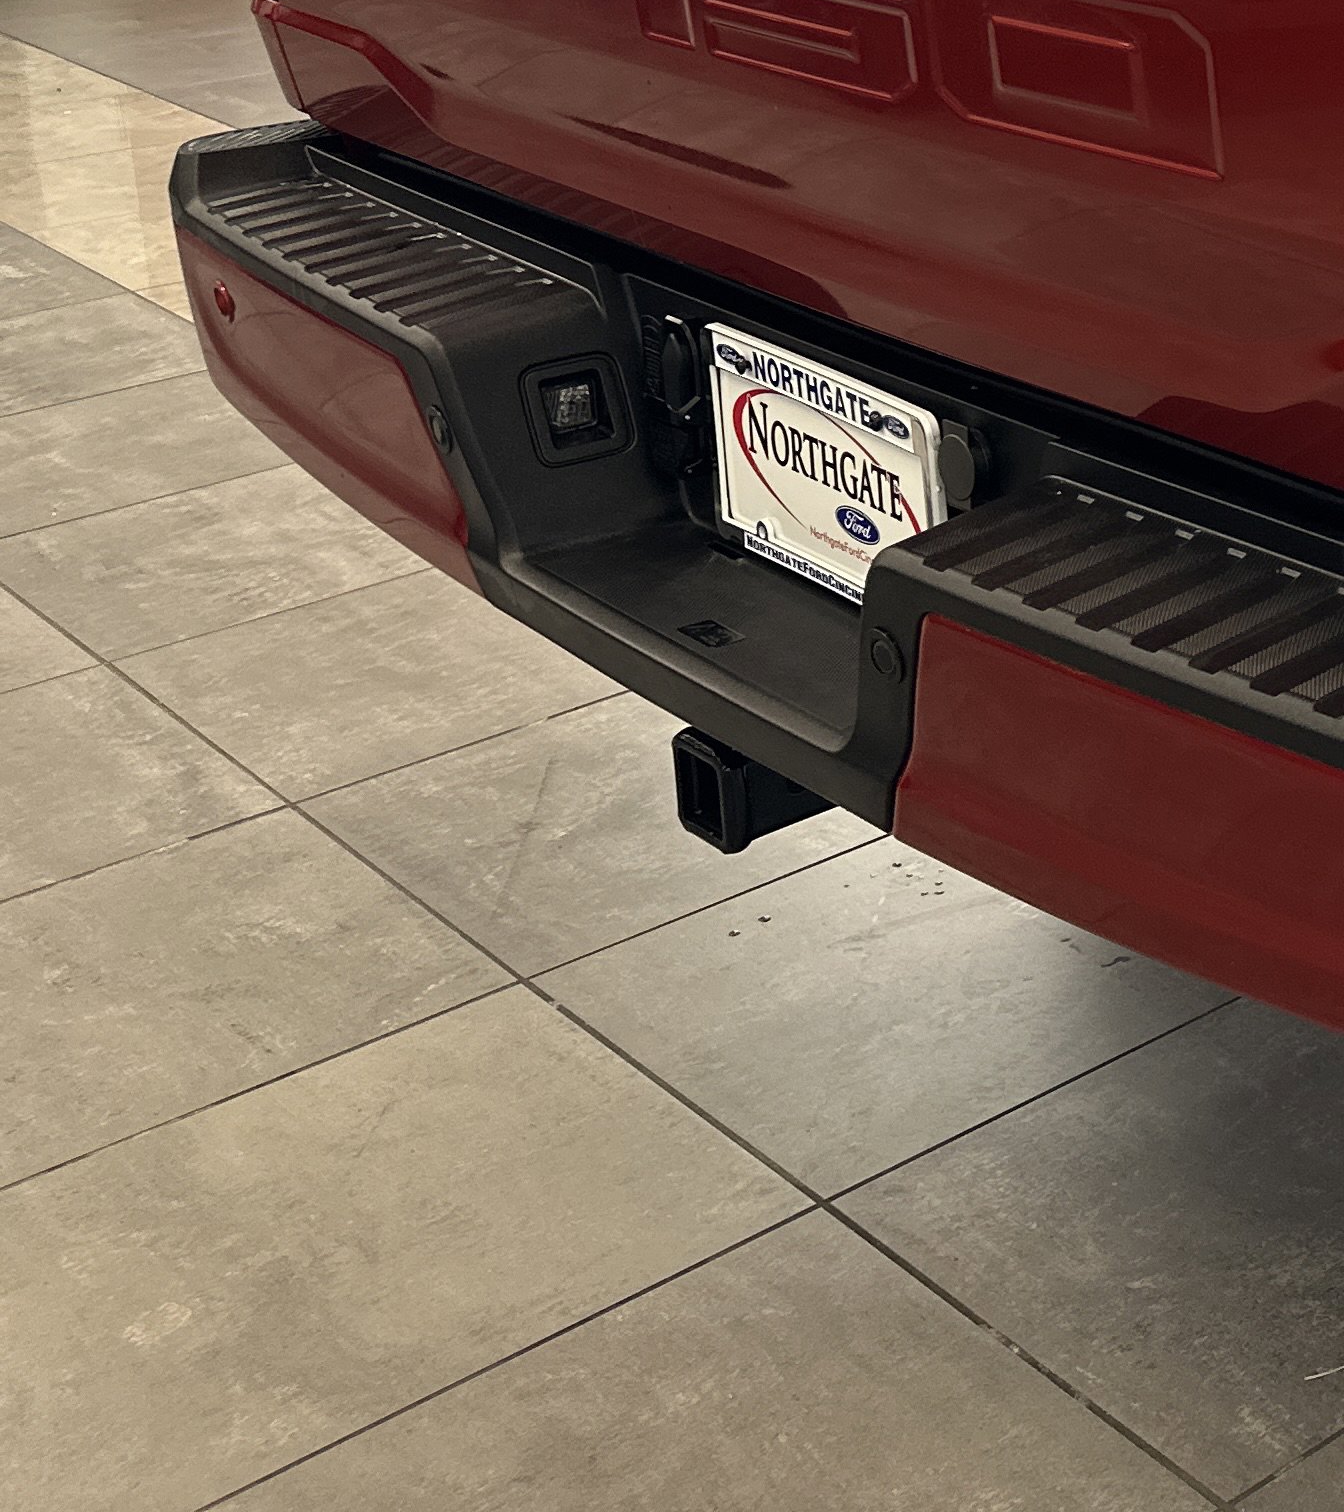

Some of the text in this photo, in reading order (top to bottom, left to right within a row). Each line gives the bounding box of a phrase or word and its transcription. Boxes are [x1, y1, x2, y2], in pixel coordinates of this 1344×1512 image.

[752, 351, 871, 426] NORTHGATE
[747, 393, 903, 523] NORTHGATE
[844, 510, 872, 540] Ford
